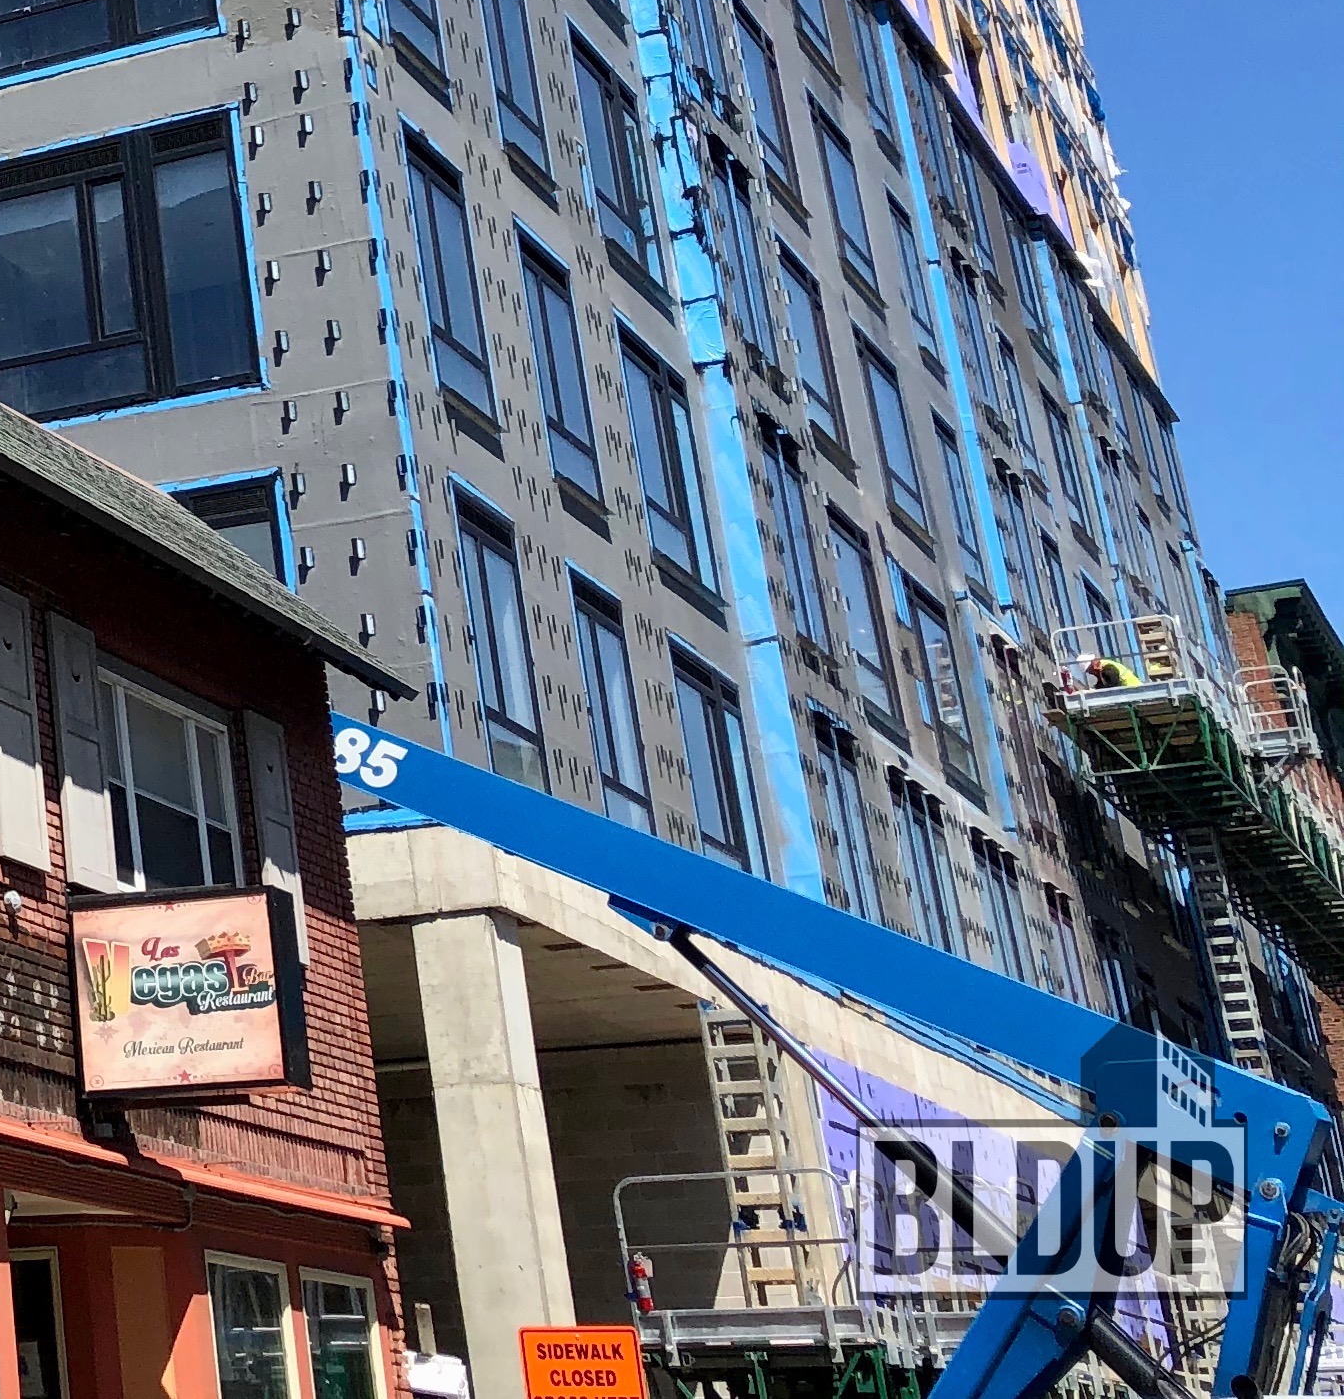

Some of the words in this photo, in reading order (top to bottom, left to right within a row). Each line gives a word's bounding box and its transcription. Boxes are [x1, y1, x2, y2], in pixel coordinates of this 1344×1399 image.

[335, 727, 409, 788] 85
[141, 936, 181, 962] Las
[242, 965, 274, 986] Bar
[197, 985, 274, 1012] Restaurant
[123, 1040, 175, 1058] Mexican
[178, 1036, 245, 1055] Restaurant
[536, 1342, 625, 1361] SIDEWALK
[549, 1369, 618, 1387] CLOSED
